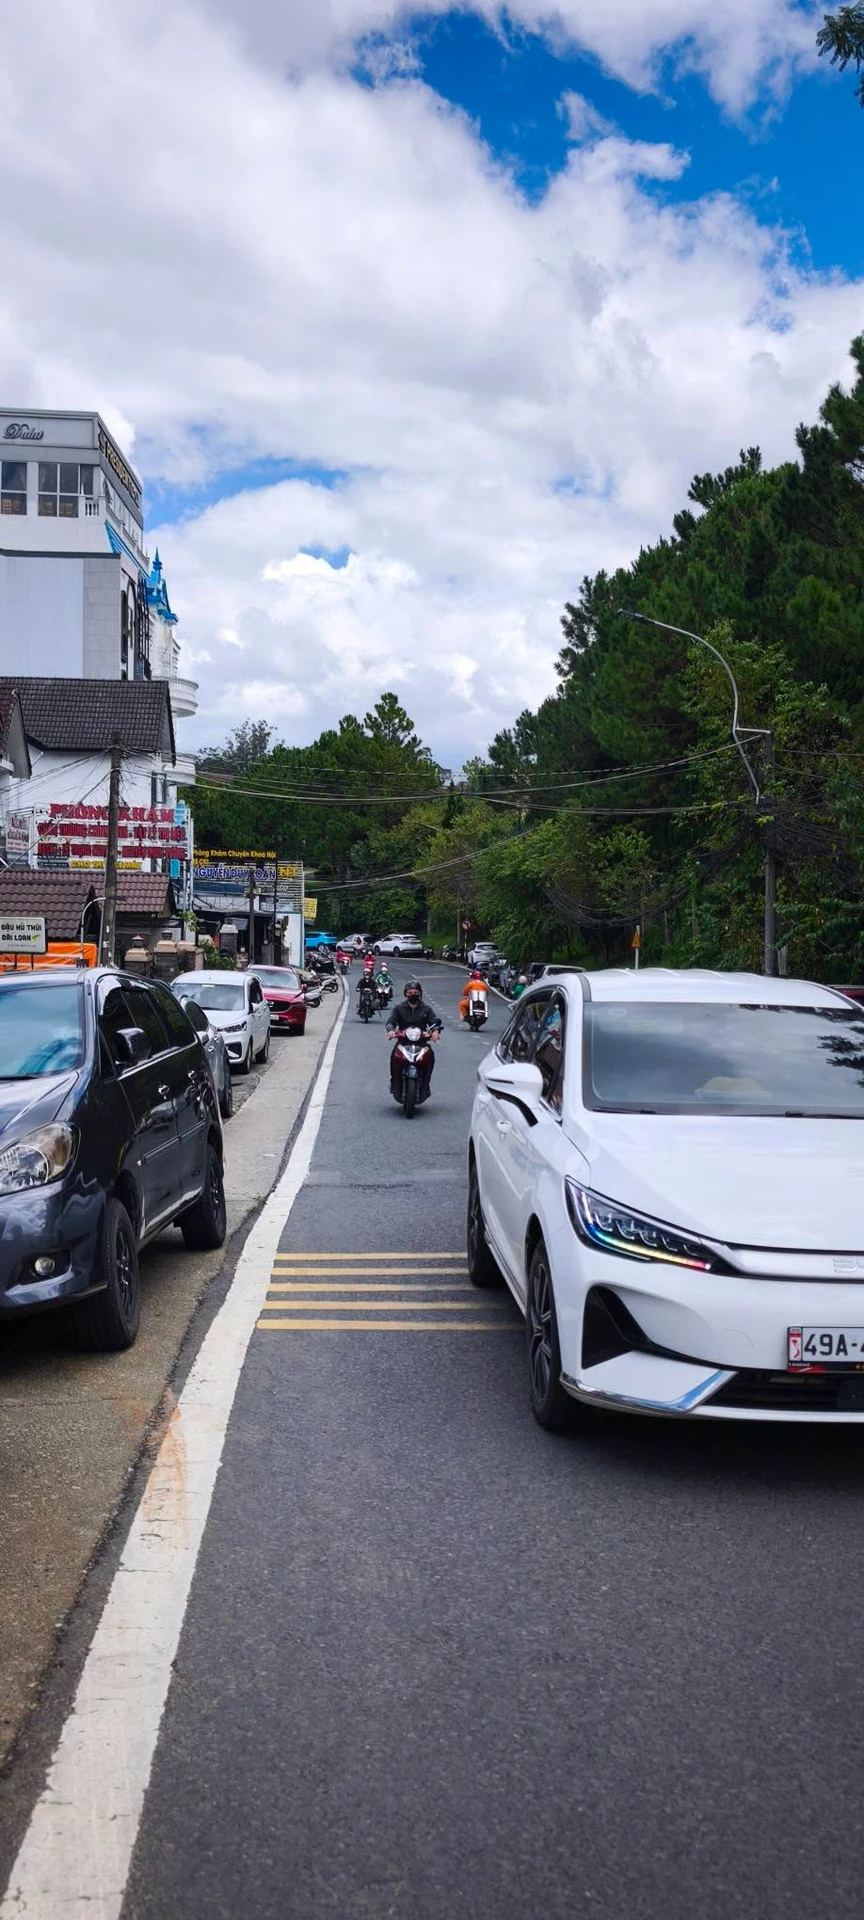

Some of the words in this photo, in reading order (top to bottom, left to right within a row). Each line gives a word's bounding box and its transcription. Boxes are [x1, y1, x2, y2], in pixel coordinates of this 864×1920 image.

[211, 849, 227, 857] Khám
[228, 850, 250, 858] Chuyên
[14, 934, 31, 942] LOAN
